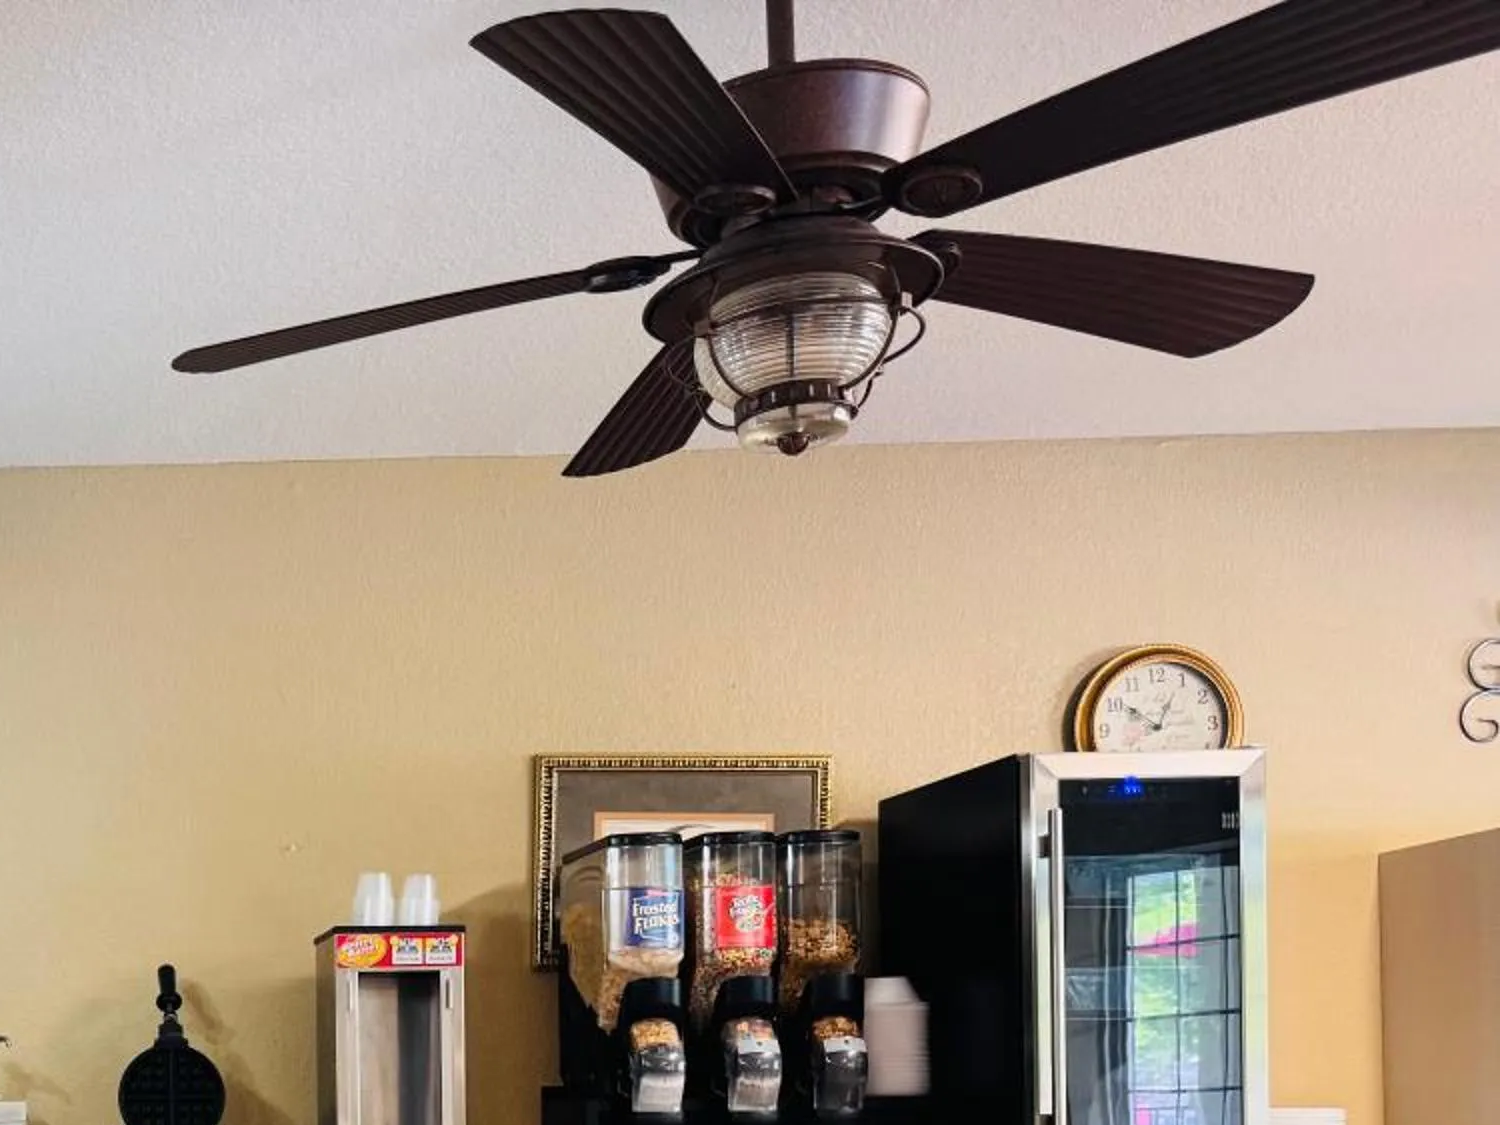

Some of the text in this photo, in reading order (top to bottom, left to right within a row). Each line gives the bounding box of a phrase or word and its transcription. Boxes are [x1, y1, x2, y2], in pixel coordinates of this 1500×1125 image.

[1148, 667, 1165, 684] 12
[1178, 673, 1186, 688] 1
[1125, 676, 1140, 692] 11
[1197, 688, 1209, 705] 2
[1107, 697, 1123, 713] 10
[1099, 723, 1110, 739] 9
[1207, 715, 1219, 731] 3
